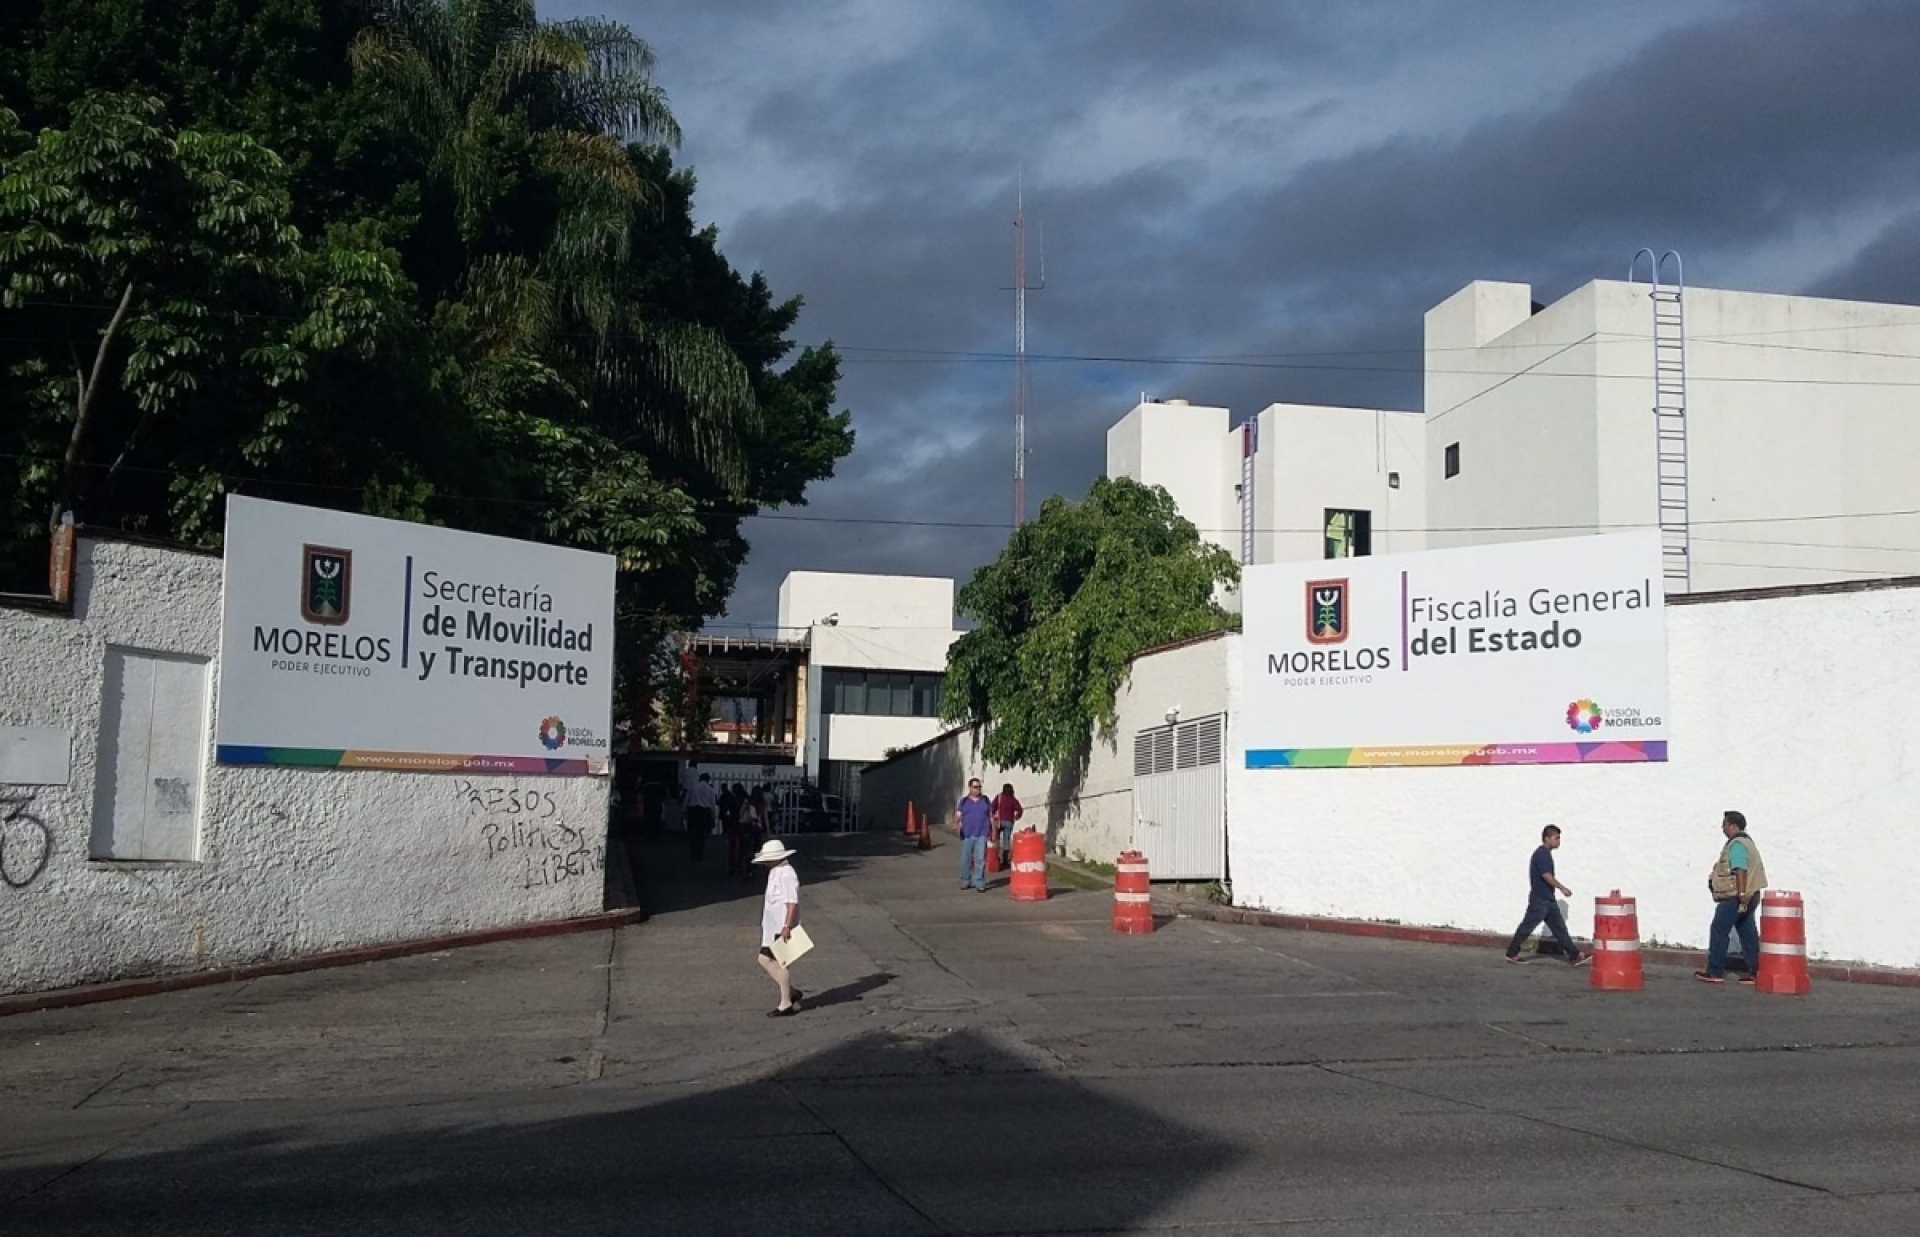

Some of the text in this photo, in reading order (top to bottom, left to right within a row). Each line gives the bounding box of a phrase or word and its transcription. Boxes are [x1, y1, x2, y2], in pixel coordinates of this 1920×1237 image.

[422, 570, 553, 613] Secretaría
[1411, 578, 1650, 623] Fiscalía General
[422, 604, 593, 652] de Movilidad
[1410, 619, 1582, 656] del Estado
[253, 625, 391, 663] MORELOS
[271, 659, 371, 677] PODER EJECUTIVO
[418, 646, 588, 688] y Transporte
[1268, 647, 1391, 674] MORELOS
[1284, 675, 1373, 686] PODER EJECUTIVO
[1605, 716, 1662, 727] MORELOS
[567, 737, 607, 748] MORELOS
[1364, 745, 1538, 758] www.morelos.gob.mx
[355, 755, 515, 768] www.morelos.gob.mx
